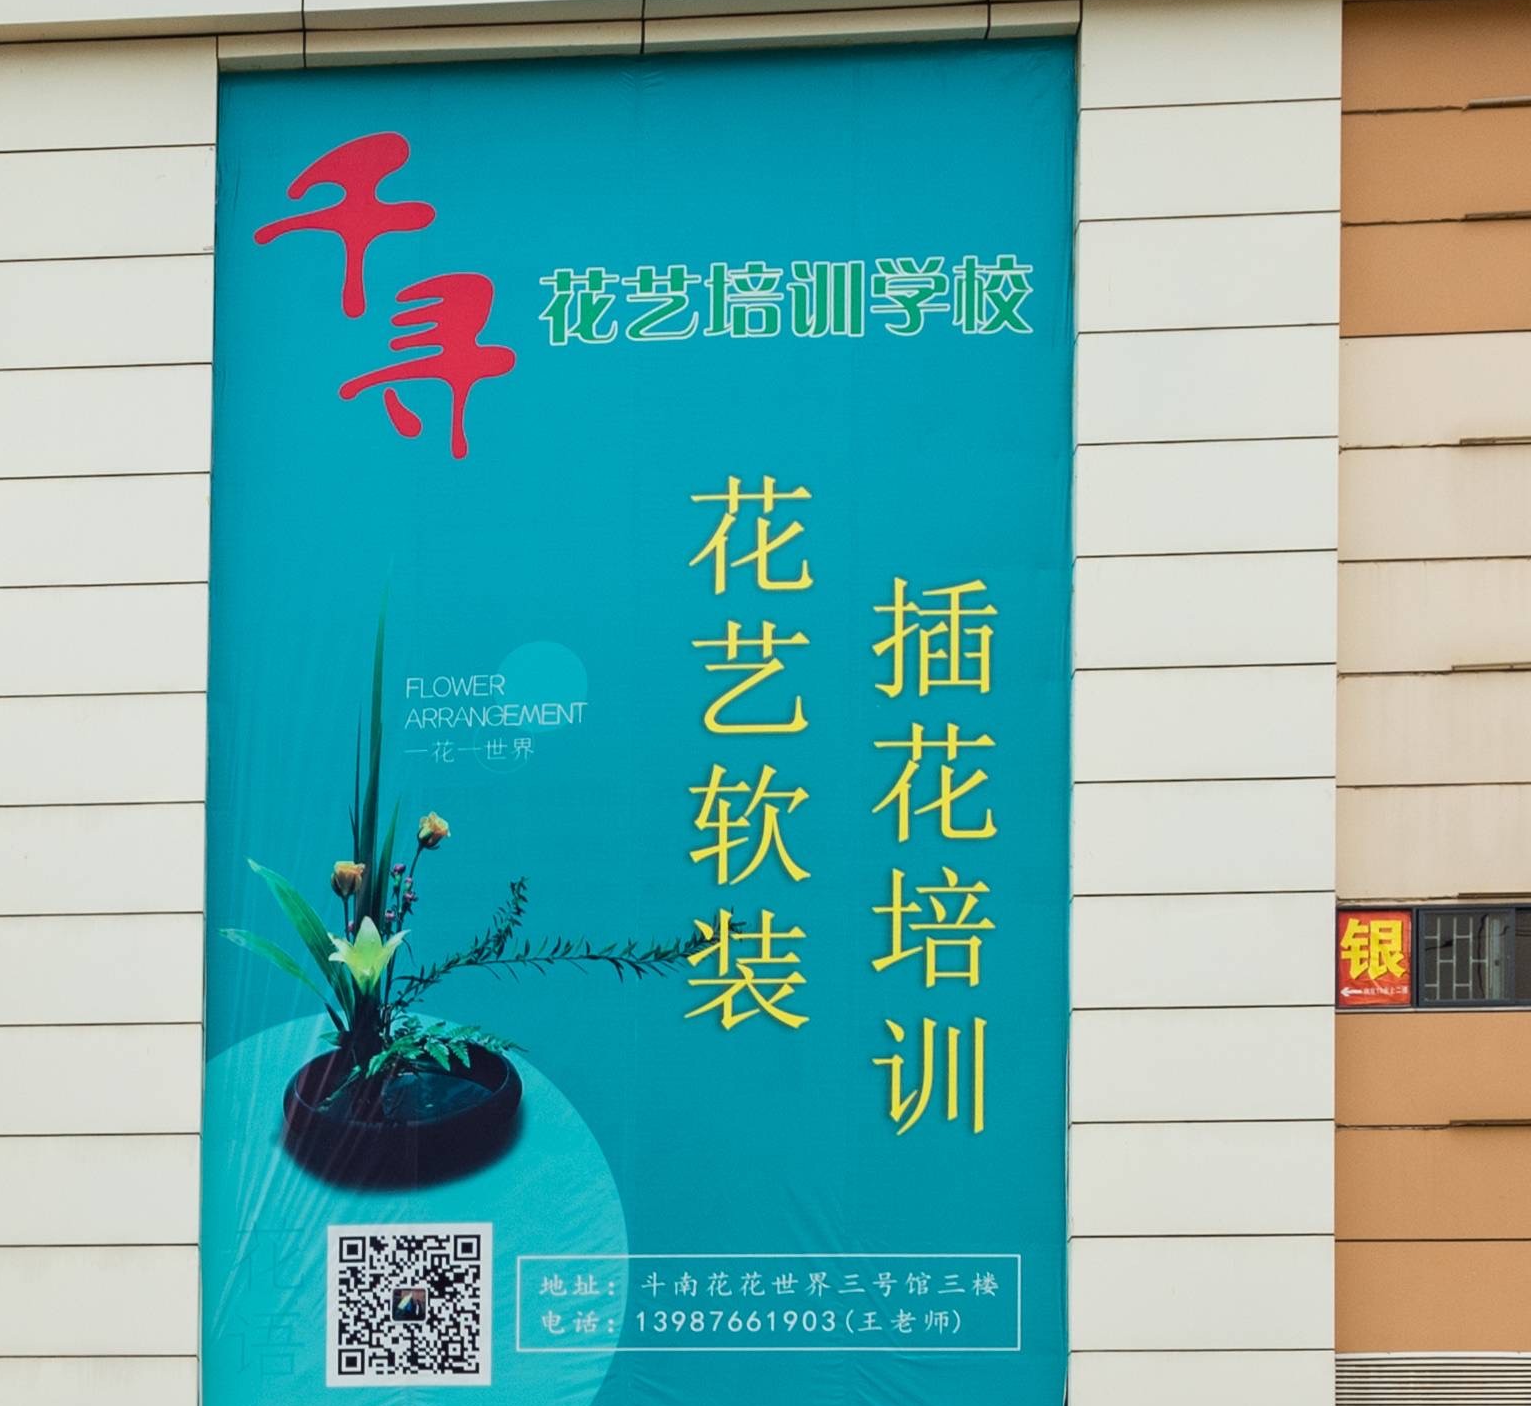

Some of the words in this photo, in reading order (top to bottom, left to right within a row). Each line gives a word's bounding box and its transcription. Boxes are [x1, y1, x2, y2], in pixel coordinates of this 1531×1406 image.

[252, 131, 516, 460] 千寻
[539, 254, 1033, 345] 花艺培训学校
[404, 702, 588, 729] ARRANGEMENT
[405, 674, 505, 698] FLOWER
[405, 736, 536, 761] 一花一世界
[683, 473, 814, 1030] 花艺软装
[871, 576, 999, 1136] 插花培训
[1340, 917, 1407, 980] 银
